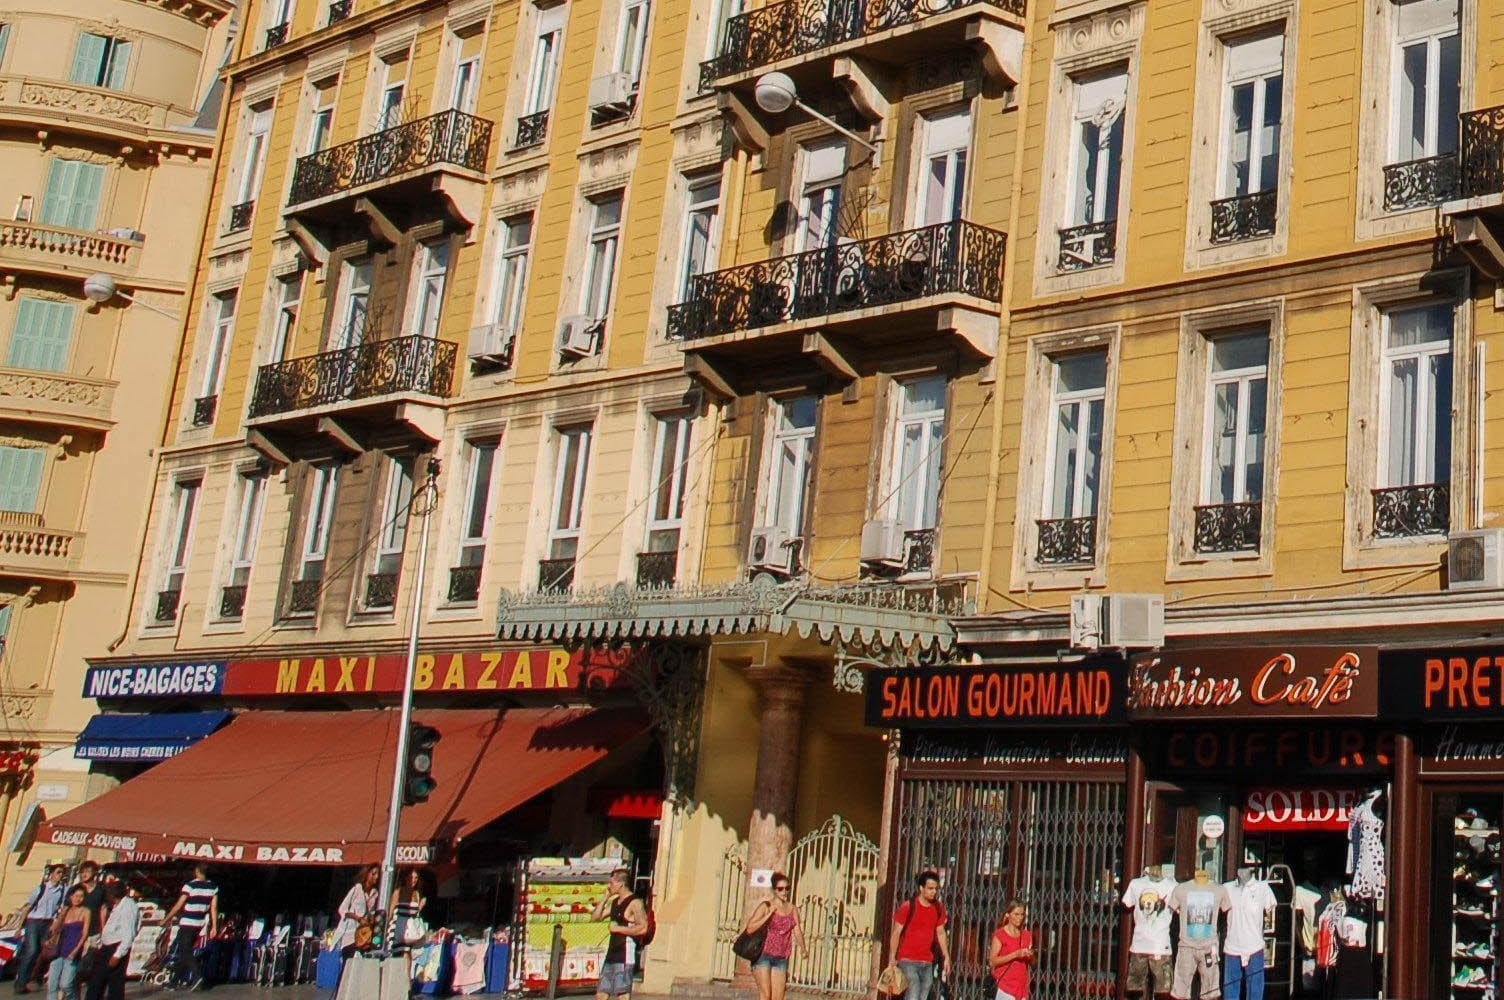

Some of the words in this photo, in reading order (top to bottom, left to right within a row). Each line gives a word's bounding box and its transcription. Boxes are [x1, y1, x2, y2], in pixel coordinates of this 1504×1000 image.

[89, 664, 218, 697] NICE-BAGAGES
[275, 655, 377, 694] MAXI
[413, 650, 571, 691] BAZAR
[1251, 652, 1361, 710] Café
[882, 674, 960, 719] SALON
[967, 670, 1112, 718] GOURMAND
[51, 830, 89, 846] CADEAUX
[93, 832, 138, 851] SOUVENIRS
[173, 841, 244, 860] MAXI
[256, 846, 344, 863] BAZAR
